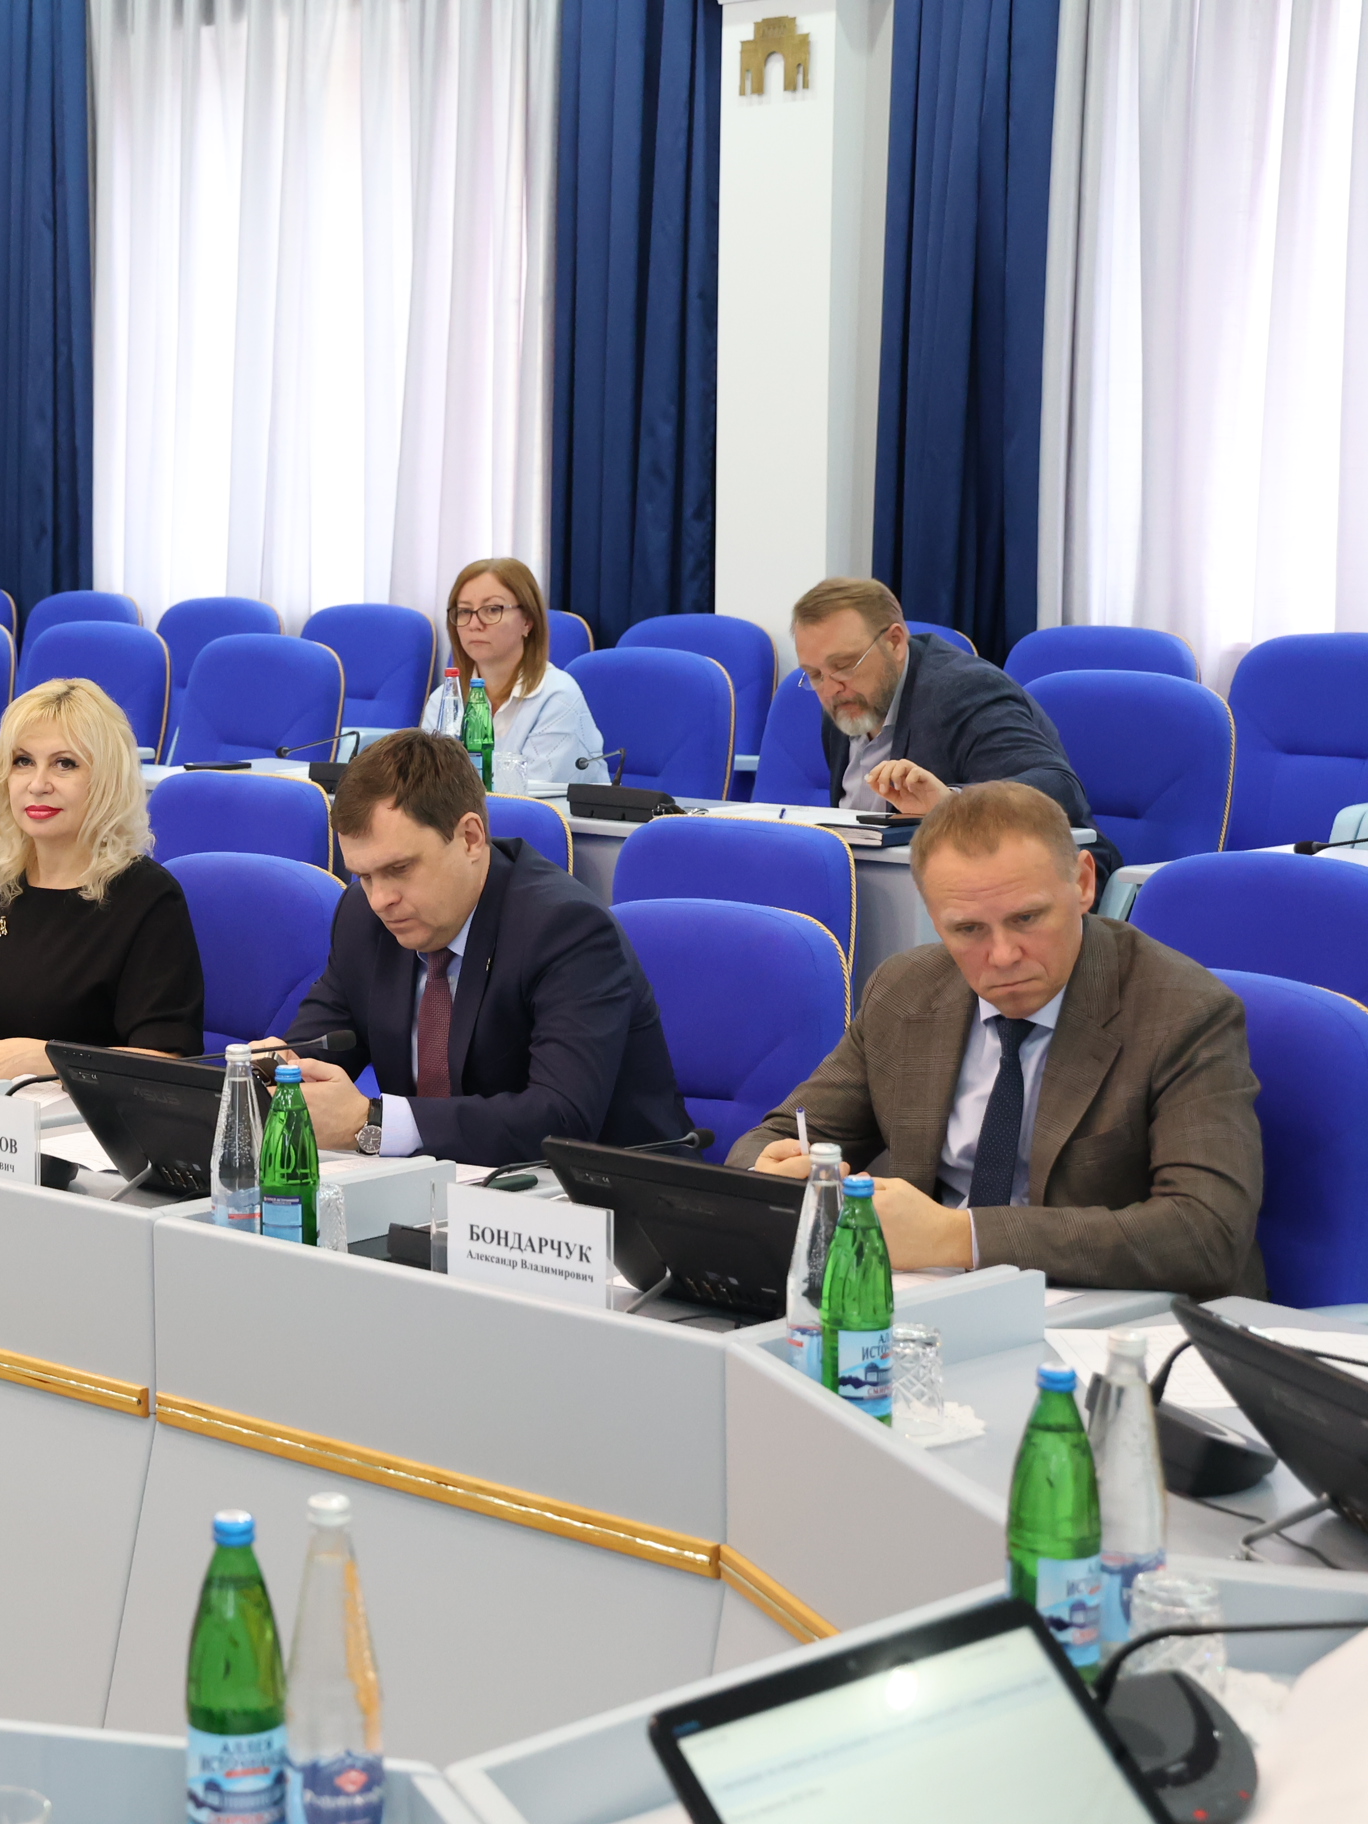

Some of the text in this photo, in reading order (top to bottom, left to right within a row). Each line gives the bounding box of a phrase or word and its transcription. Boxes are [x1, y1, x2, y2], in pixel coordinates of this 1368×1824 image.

[468, 1223, 593, 1264] БОНДАРЧУК
[466, 1249, 594, 1283] Александр Владимирович
